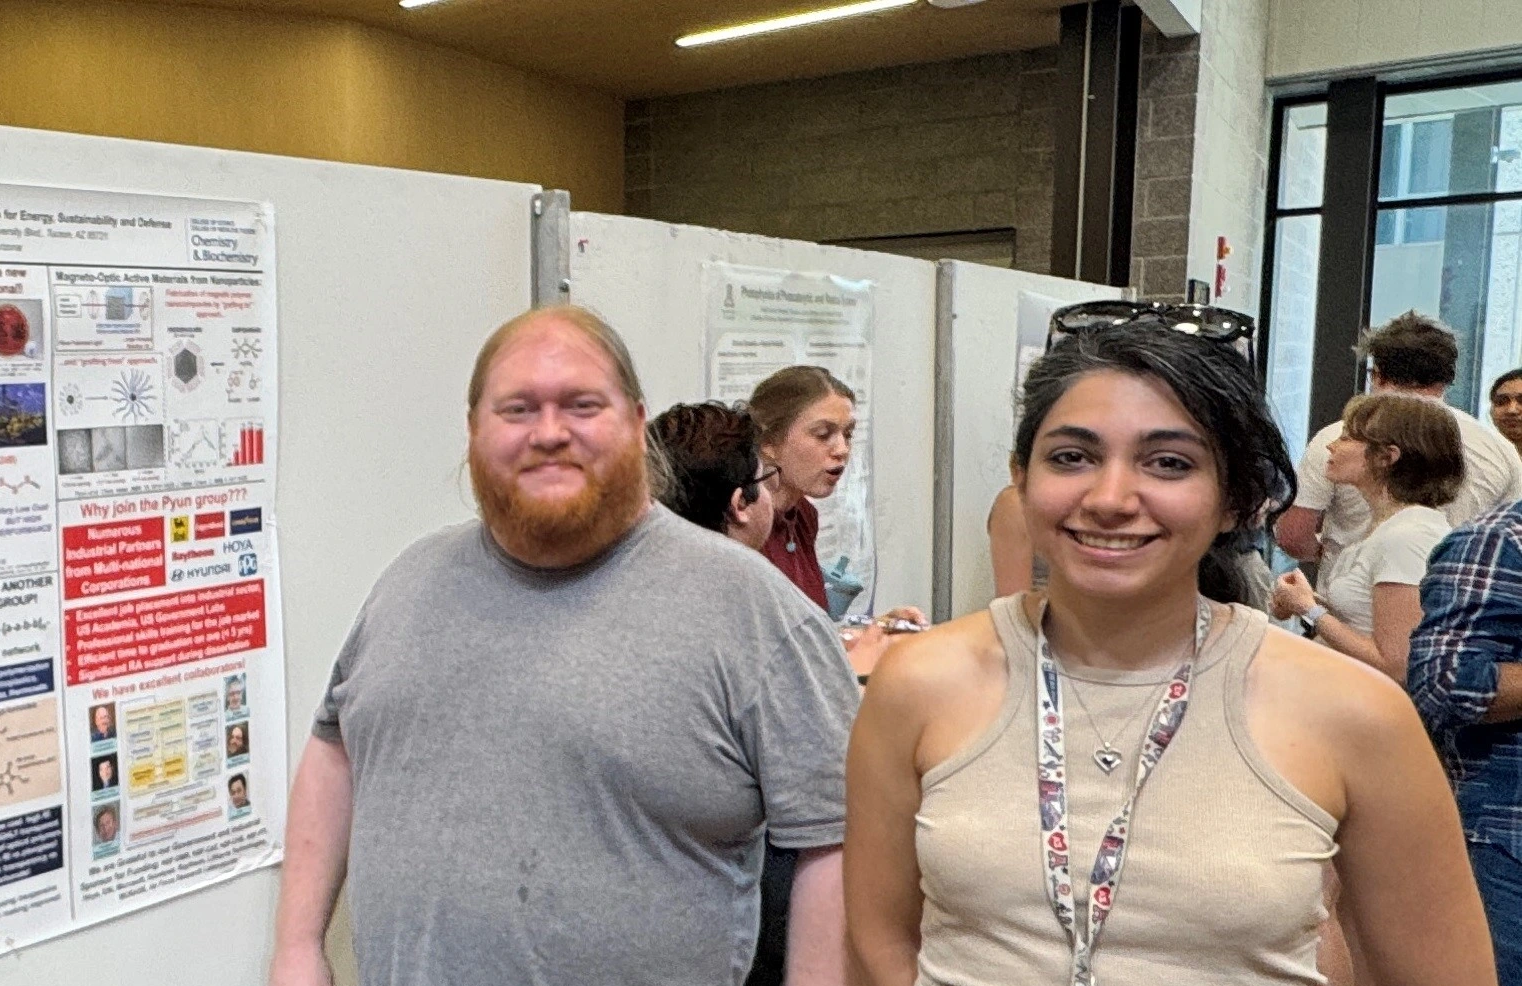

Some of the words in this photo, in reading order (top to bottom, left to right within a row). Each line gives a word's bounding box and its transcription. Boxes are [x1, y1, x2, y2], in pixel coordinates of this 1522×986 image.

[80, 503, 109, 519] Why
[111, 501, 136, 518] join
[139, 499, 158, 512] the
[161, 495, 191, 511] Pyun
[222, 539, 253, 553] HOYA
